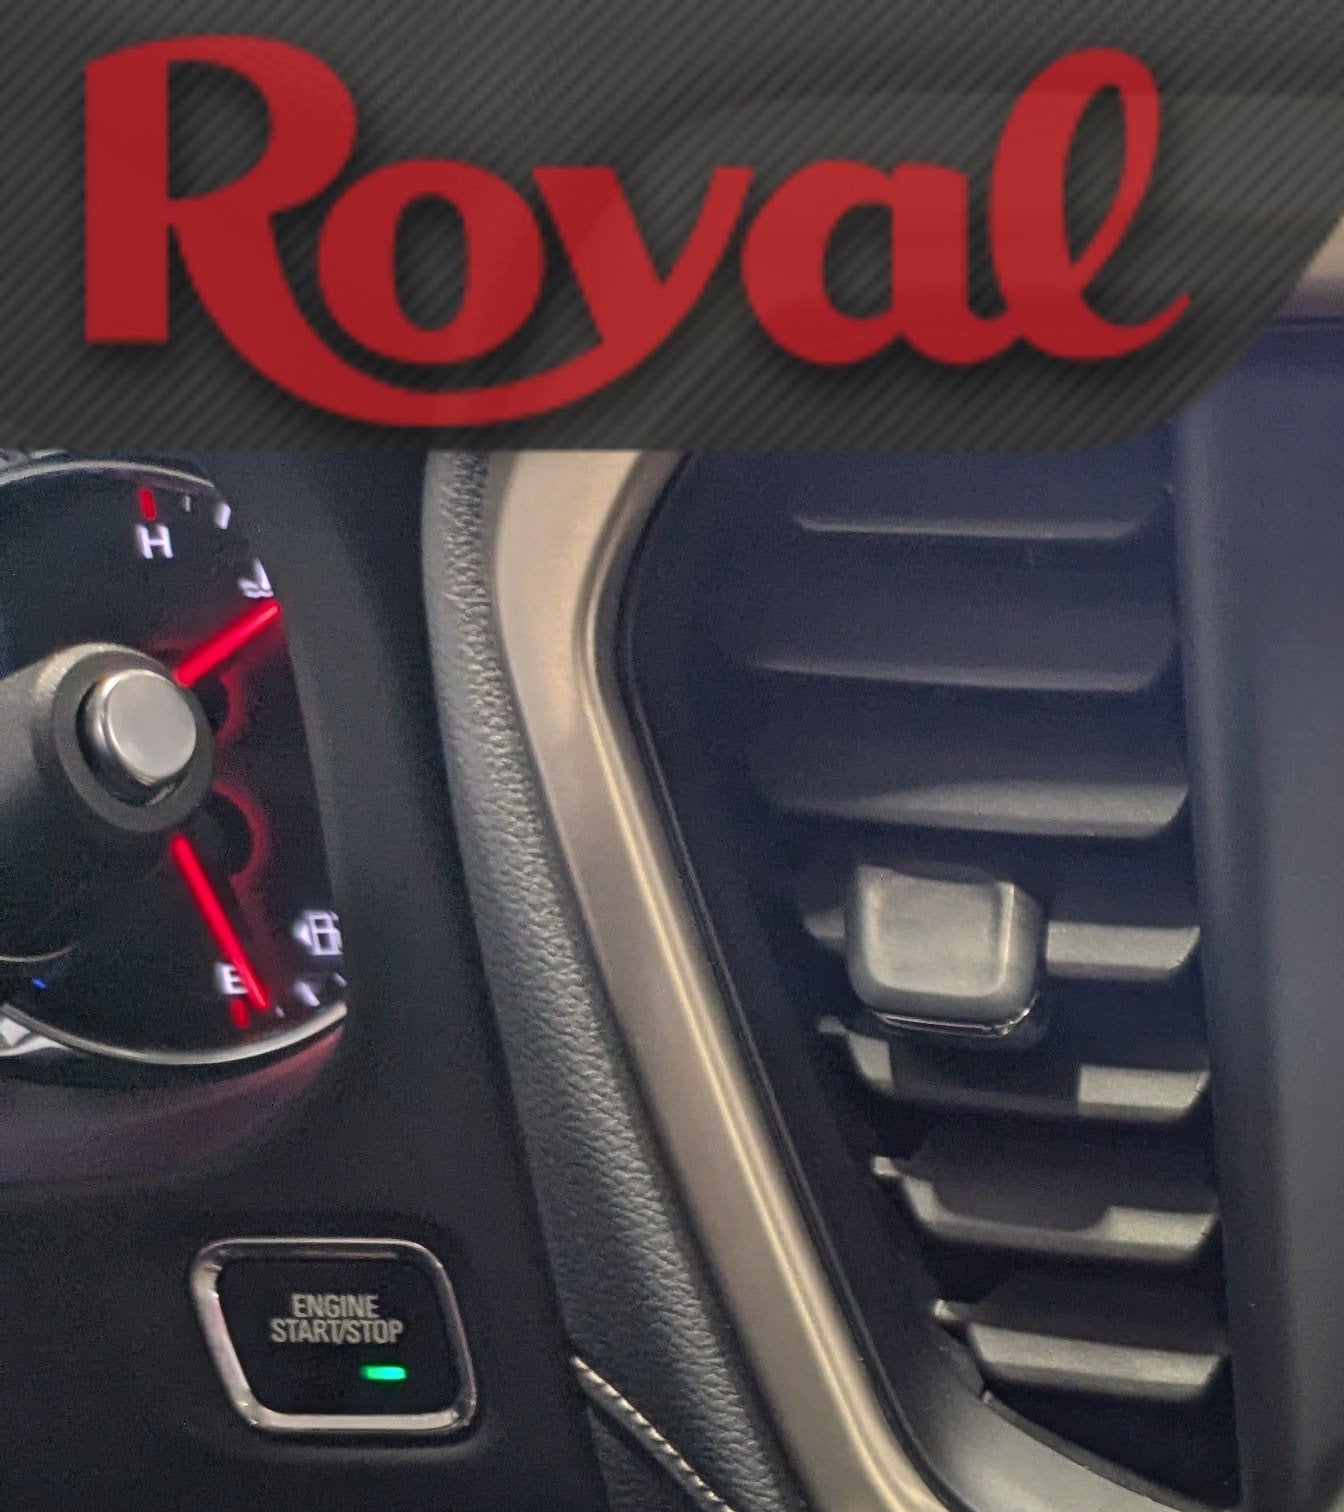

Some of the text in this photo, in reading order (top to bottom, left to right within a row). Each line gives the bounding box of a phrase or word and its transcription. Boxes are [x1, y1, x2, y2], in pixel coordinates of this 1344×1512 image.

[136, 524, 173, 559] H
[217, 964, 250, 996] E
[291, 1294, 380, 1318] ENGINE
[268, 1318, 404, 1345] START/STOP
